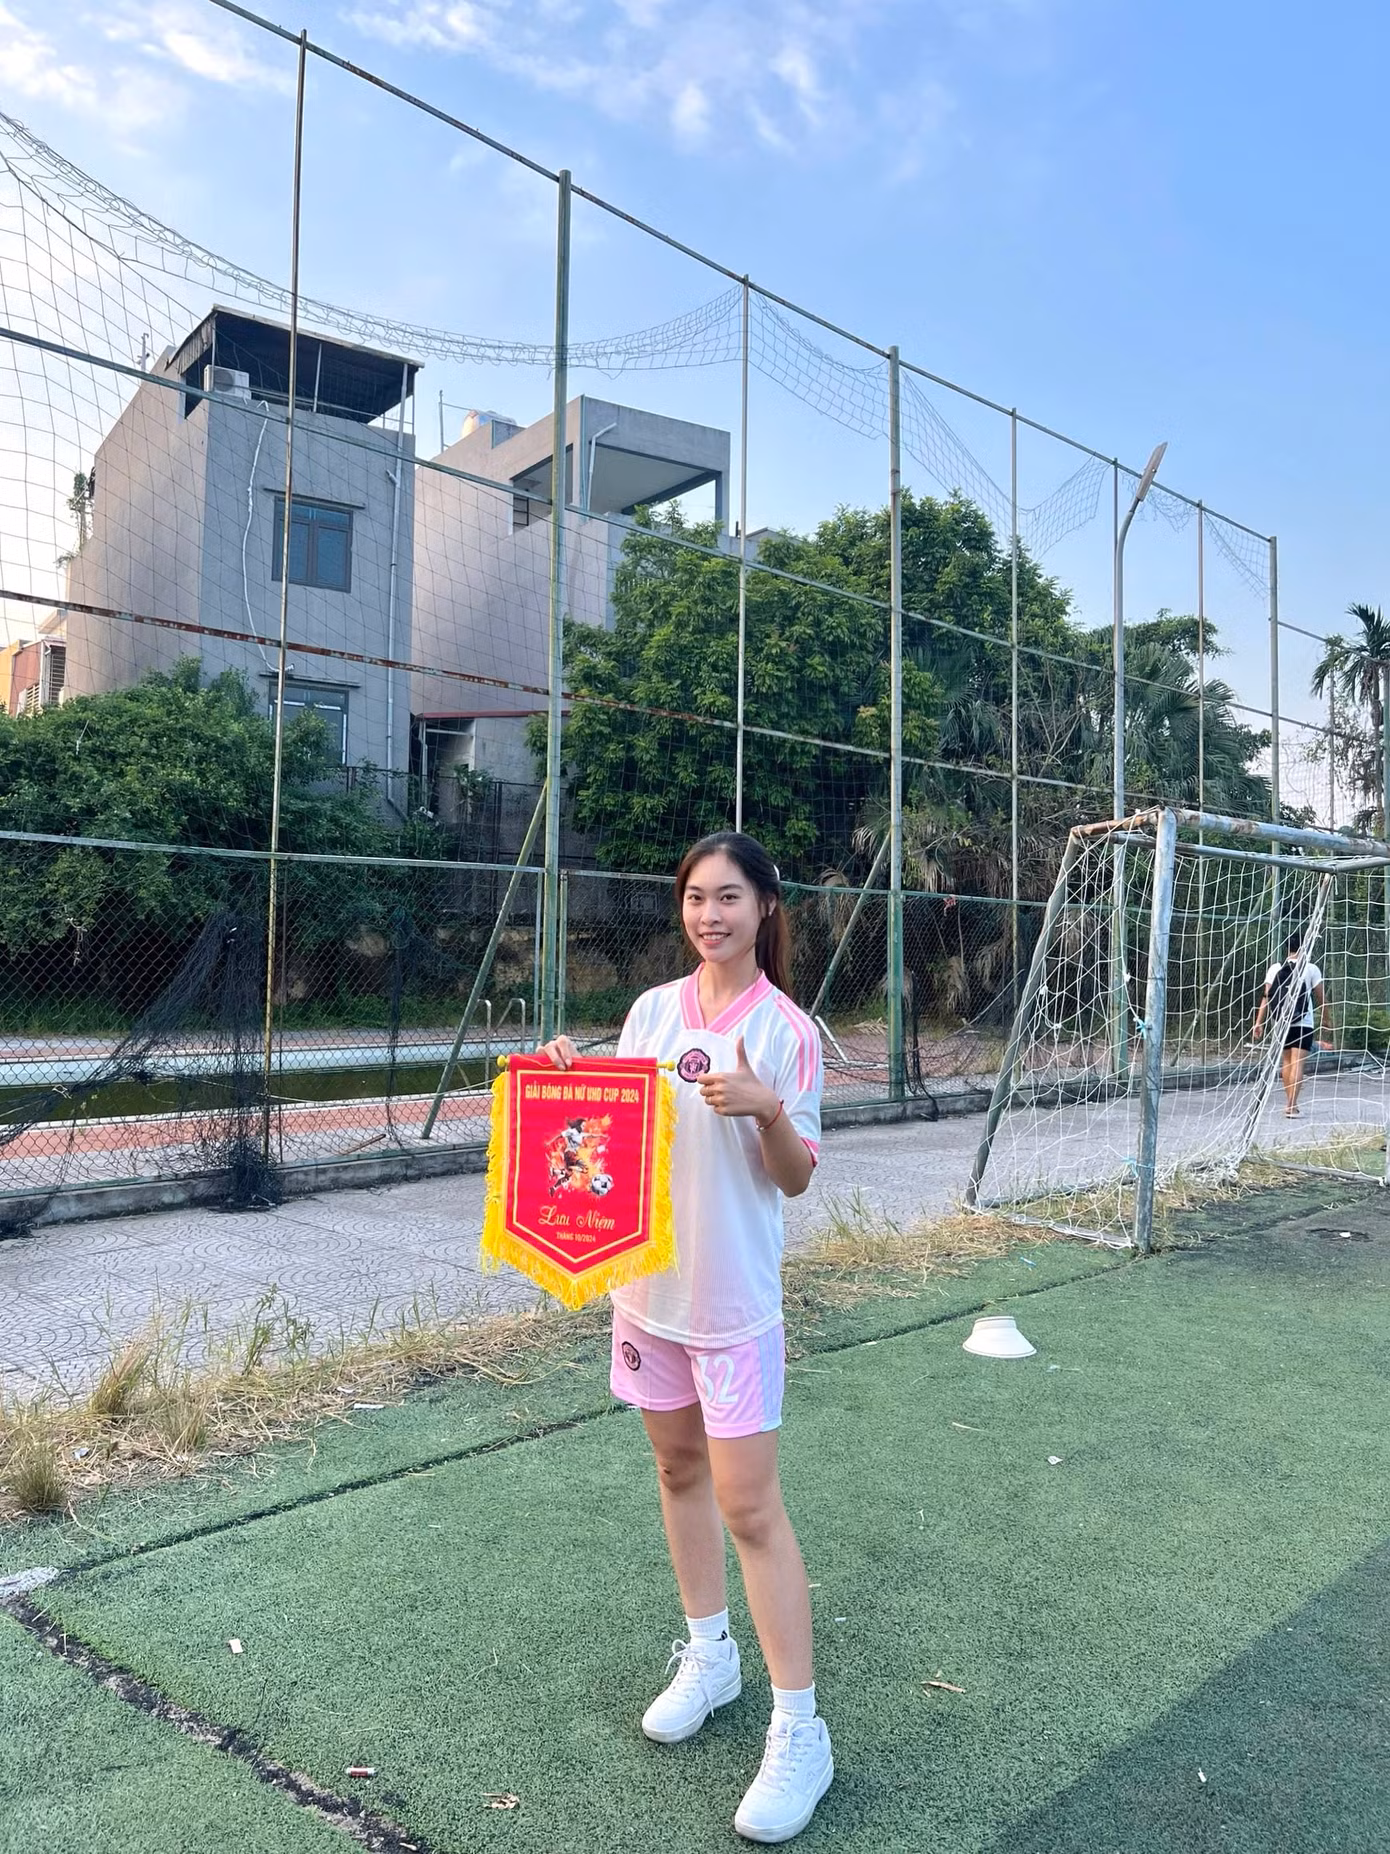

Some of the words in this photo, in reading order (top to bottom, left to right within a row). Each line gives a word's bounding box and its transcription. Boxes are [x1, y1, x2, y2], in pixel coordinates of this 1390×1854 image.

[525, 1080, 540, 1099] GIẢI
[541, 1083, 562, 1100] BÓNG
[563, 1083, 573, 1100] ĐÁ
[574, 1084, 587, 1101] NỮ
[603, 1087, 620, 1102] CUP
[621, 1088, 639, 1104] 2024
[576, 1209, 616, 1232] Niệm
